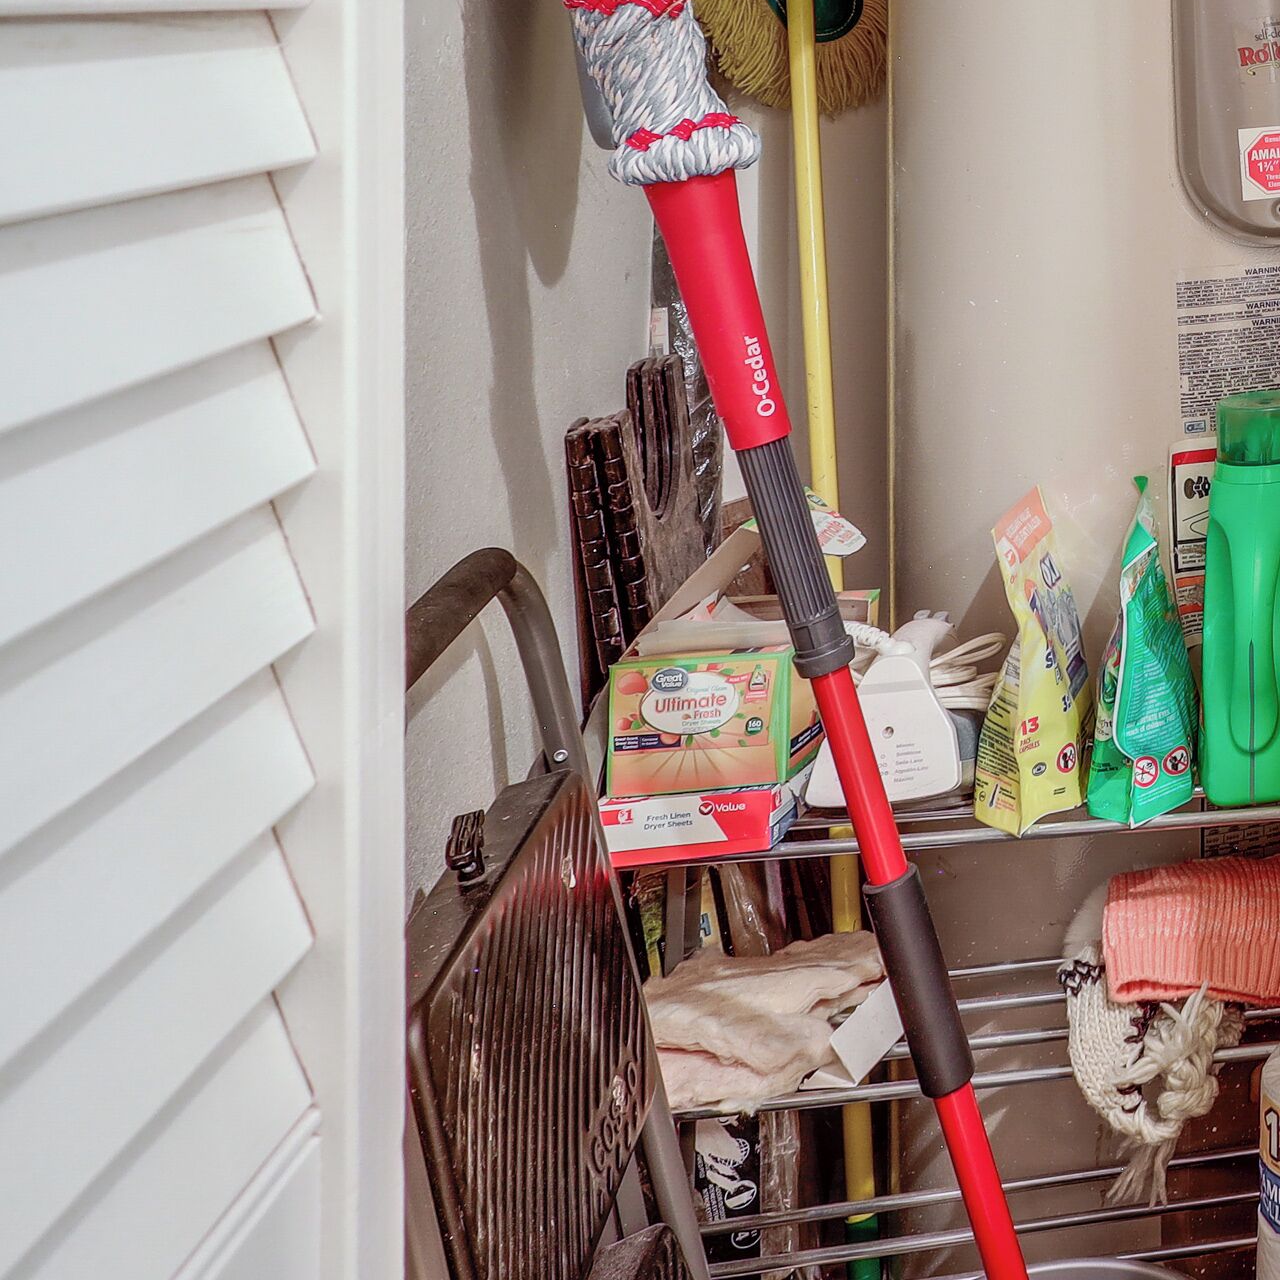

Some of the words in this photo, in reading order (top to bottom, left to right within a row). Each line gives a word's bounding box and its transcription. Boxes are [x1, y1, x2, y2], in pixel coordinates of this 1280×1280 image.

[744, 335, 776, 417] O-Cedar
[656, 672, 684, 685] Great
[661, 680, 684, 689] Value
[654, 693, 727, 714] Ultimate
[694, 709, 721, 720] Fresh
[681, 720, 700, 728] Dryer
[748, 719, 762, 729] 160
[1020, 715, 1040, 736] 13
[715, 802, 746, 813] Value
[619, 808, 634, 822] $1
[646, 813, 669, 822] Fresh
[670, 811, 691, 820] Linen
[644, 822, 667, 831] Dryer
[667, 819, 693, 829] Sheets
